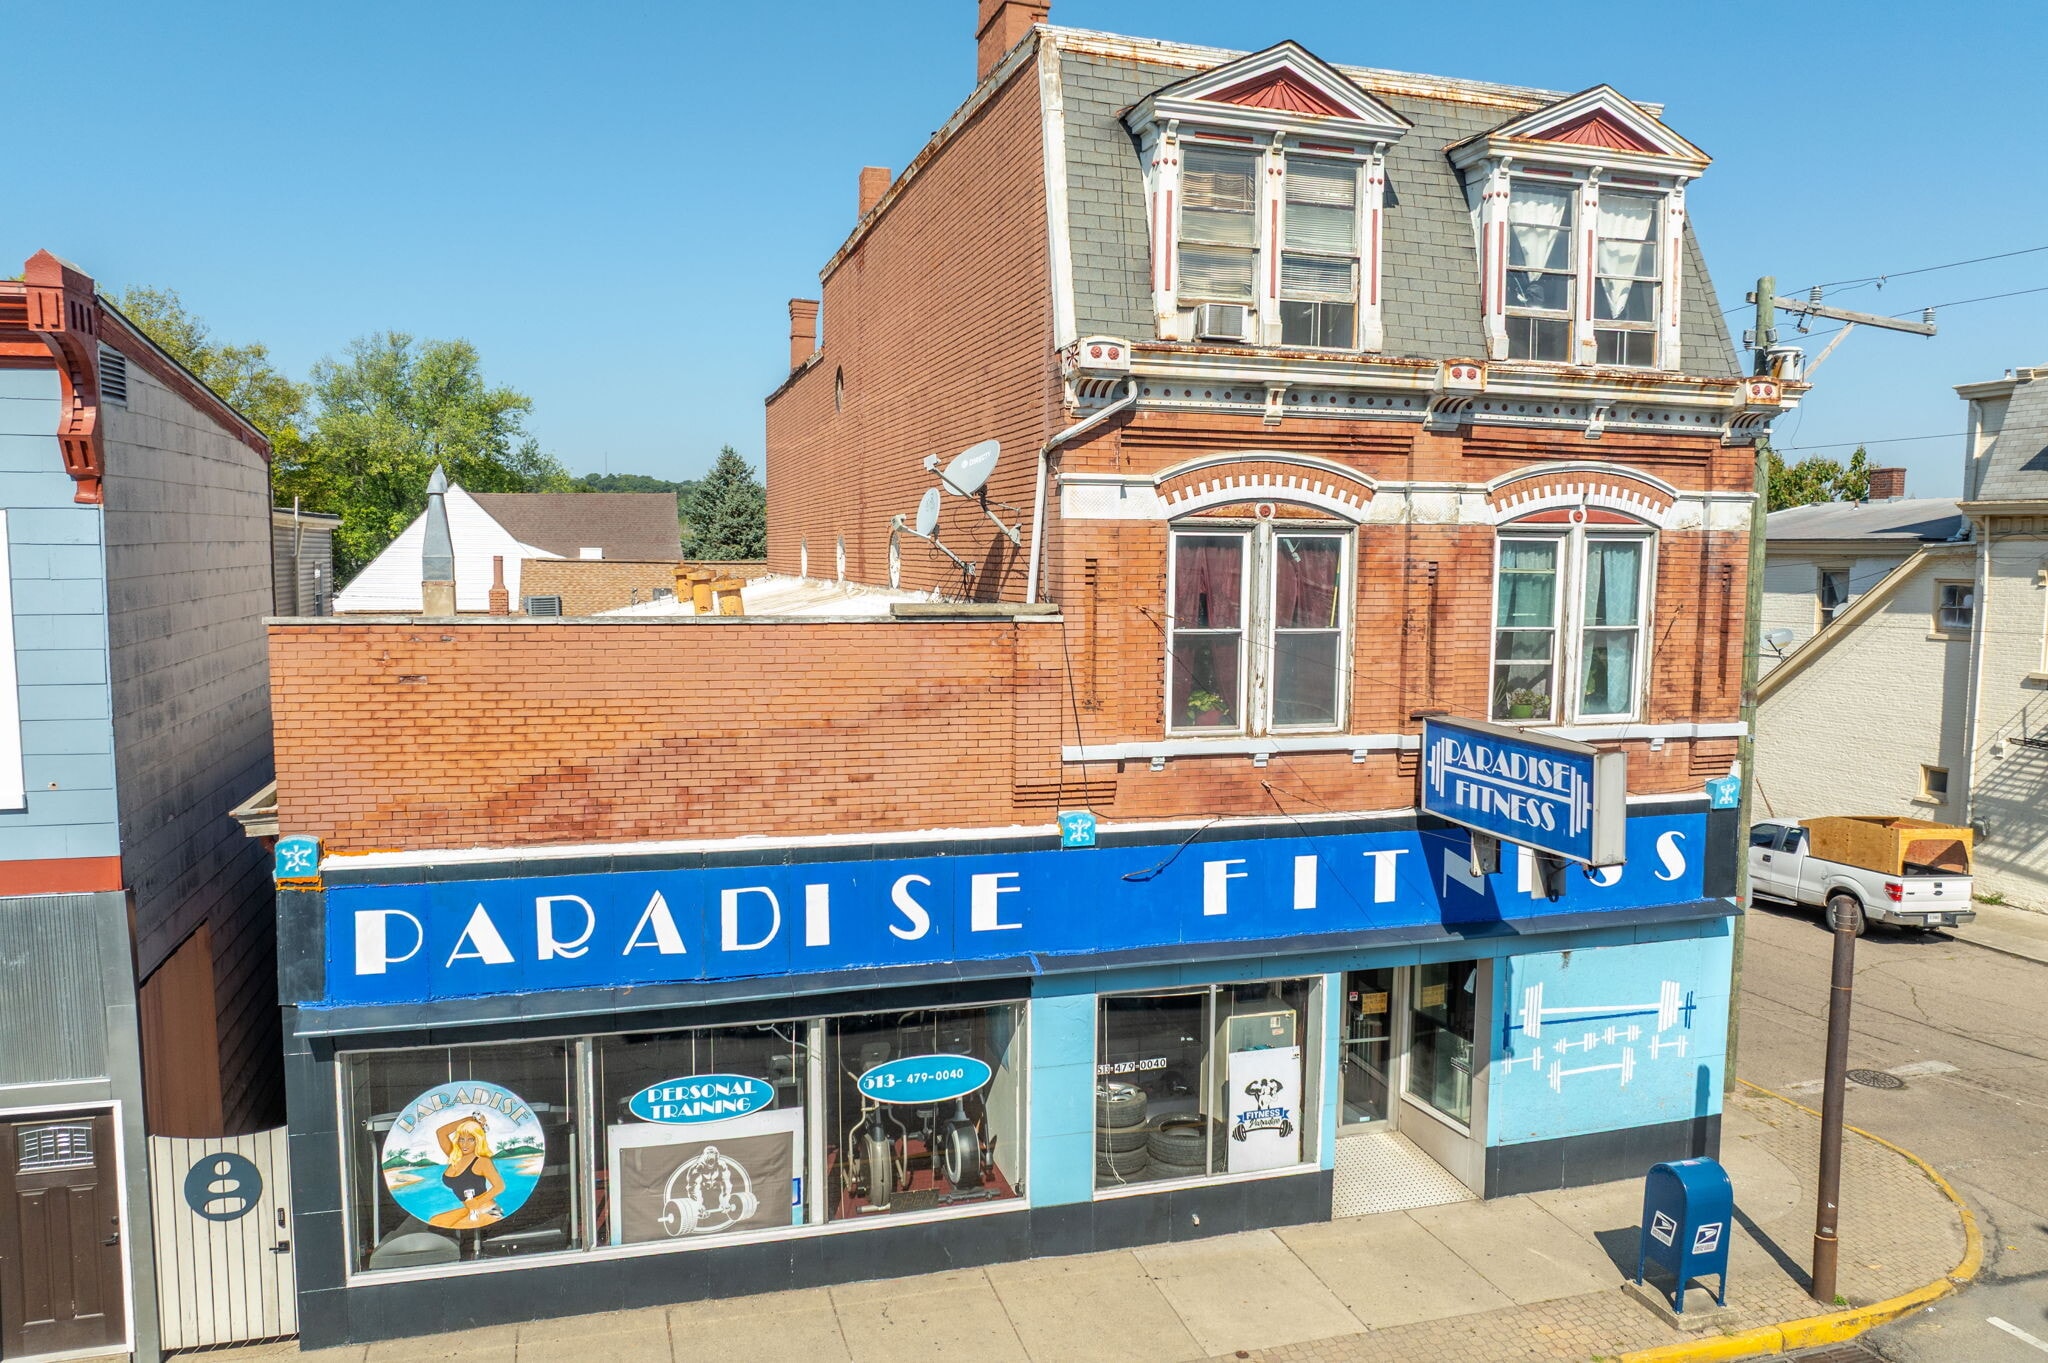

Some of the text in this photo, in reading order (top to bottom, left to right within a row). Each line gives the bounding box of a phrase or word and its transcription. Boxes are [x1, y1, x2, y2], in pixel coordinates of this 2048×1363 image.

[1445, 738, 1570, 793] PARADISE
[1456, 780, 1555, 831] FITNESS
[354, 831, 1686, 976] PARADISE FITNS
[647, 1080, 757, 1103] PERSONAL
[906, 1068, 964, 1084] 479-0040
[397, 1087, 532, 1133] PARADISE
[650, 1097, 751, 1119] TRAINING
[1246, 1109, 1280, 1120] FITNESS
